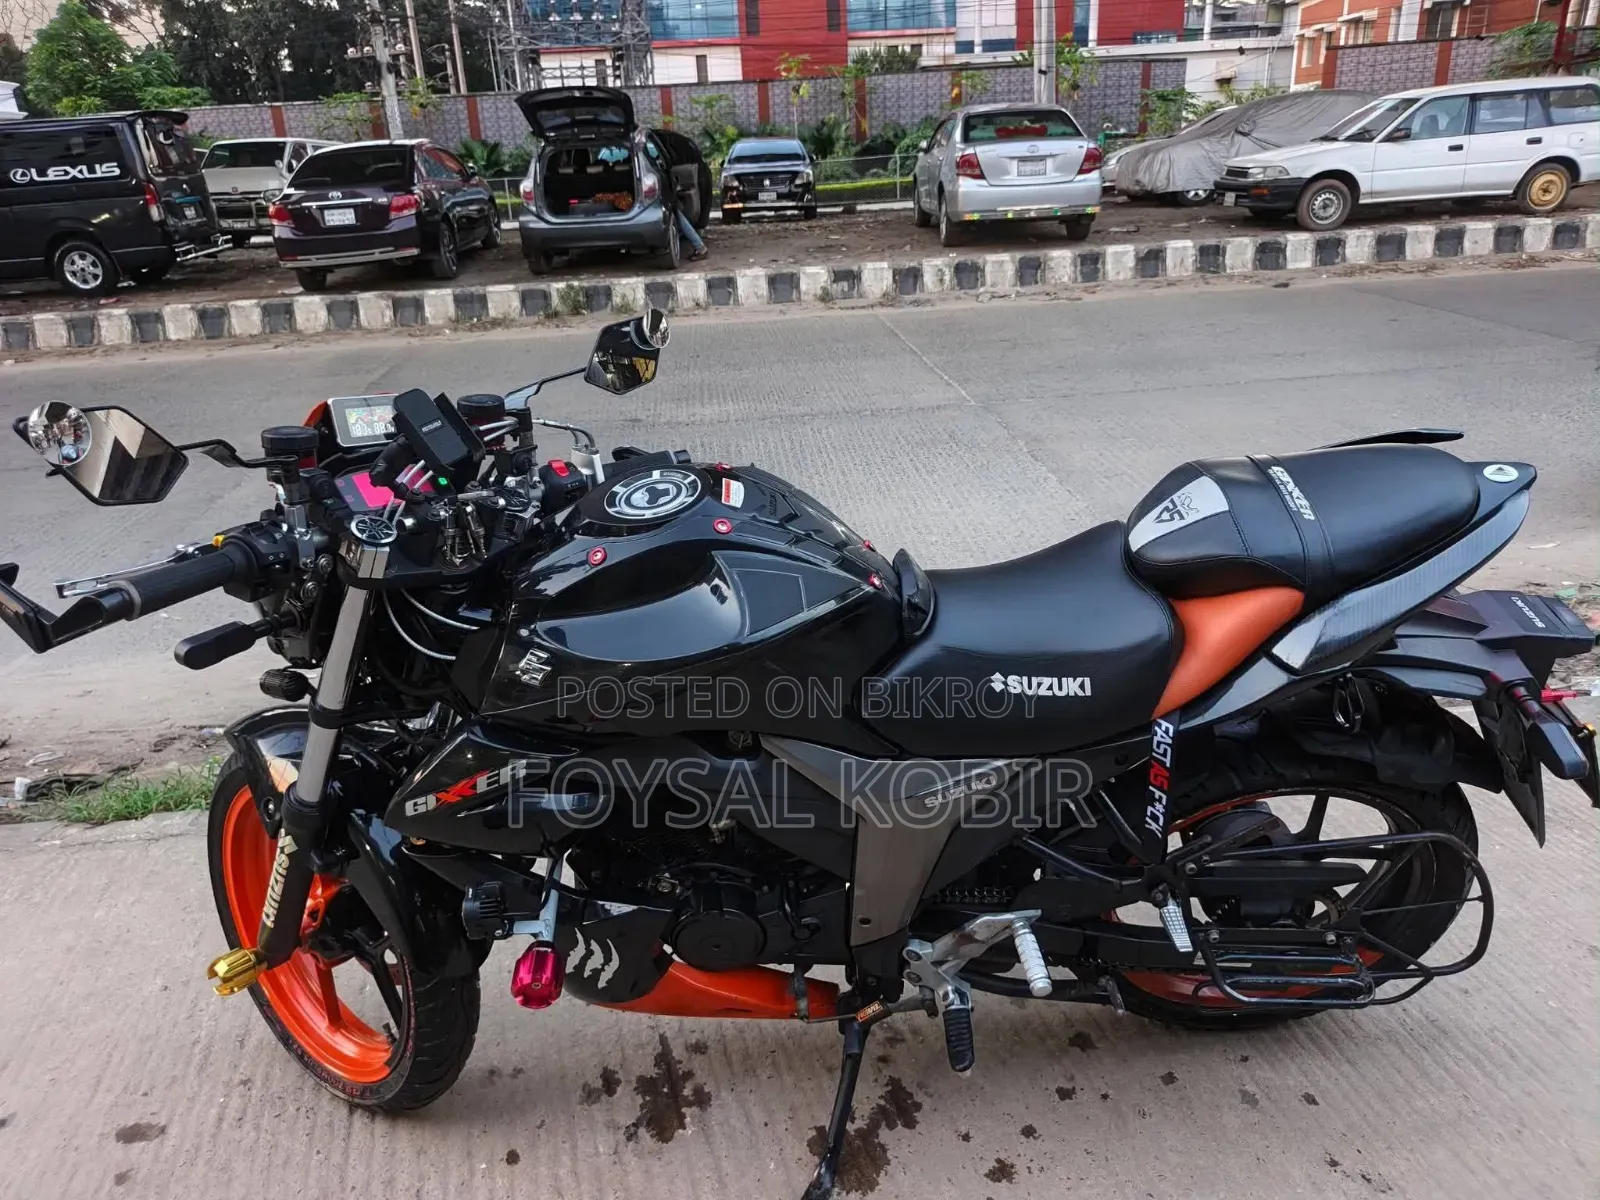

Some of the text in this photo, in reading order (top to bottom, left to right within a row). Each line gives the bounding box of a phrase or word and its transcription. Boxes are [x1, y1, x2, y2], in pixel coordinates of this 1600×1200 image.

[30, 162, 121, 182] LEXUS
[1510, 596, 1547, 629] SUZUKI
[1006, 675, 1092, 696] SUZUKI
[1152, 718, 1175, 768] FAST
[405, 759, 527, 816] GIXXER
[924, 775, 997, 808] SUZUKI
[1149, 760, 1170, 791] AS
[262, 847, 290, 929] SUZUKI
